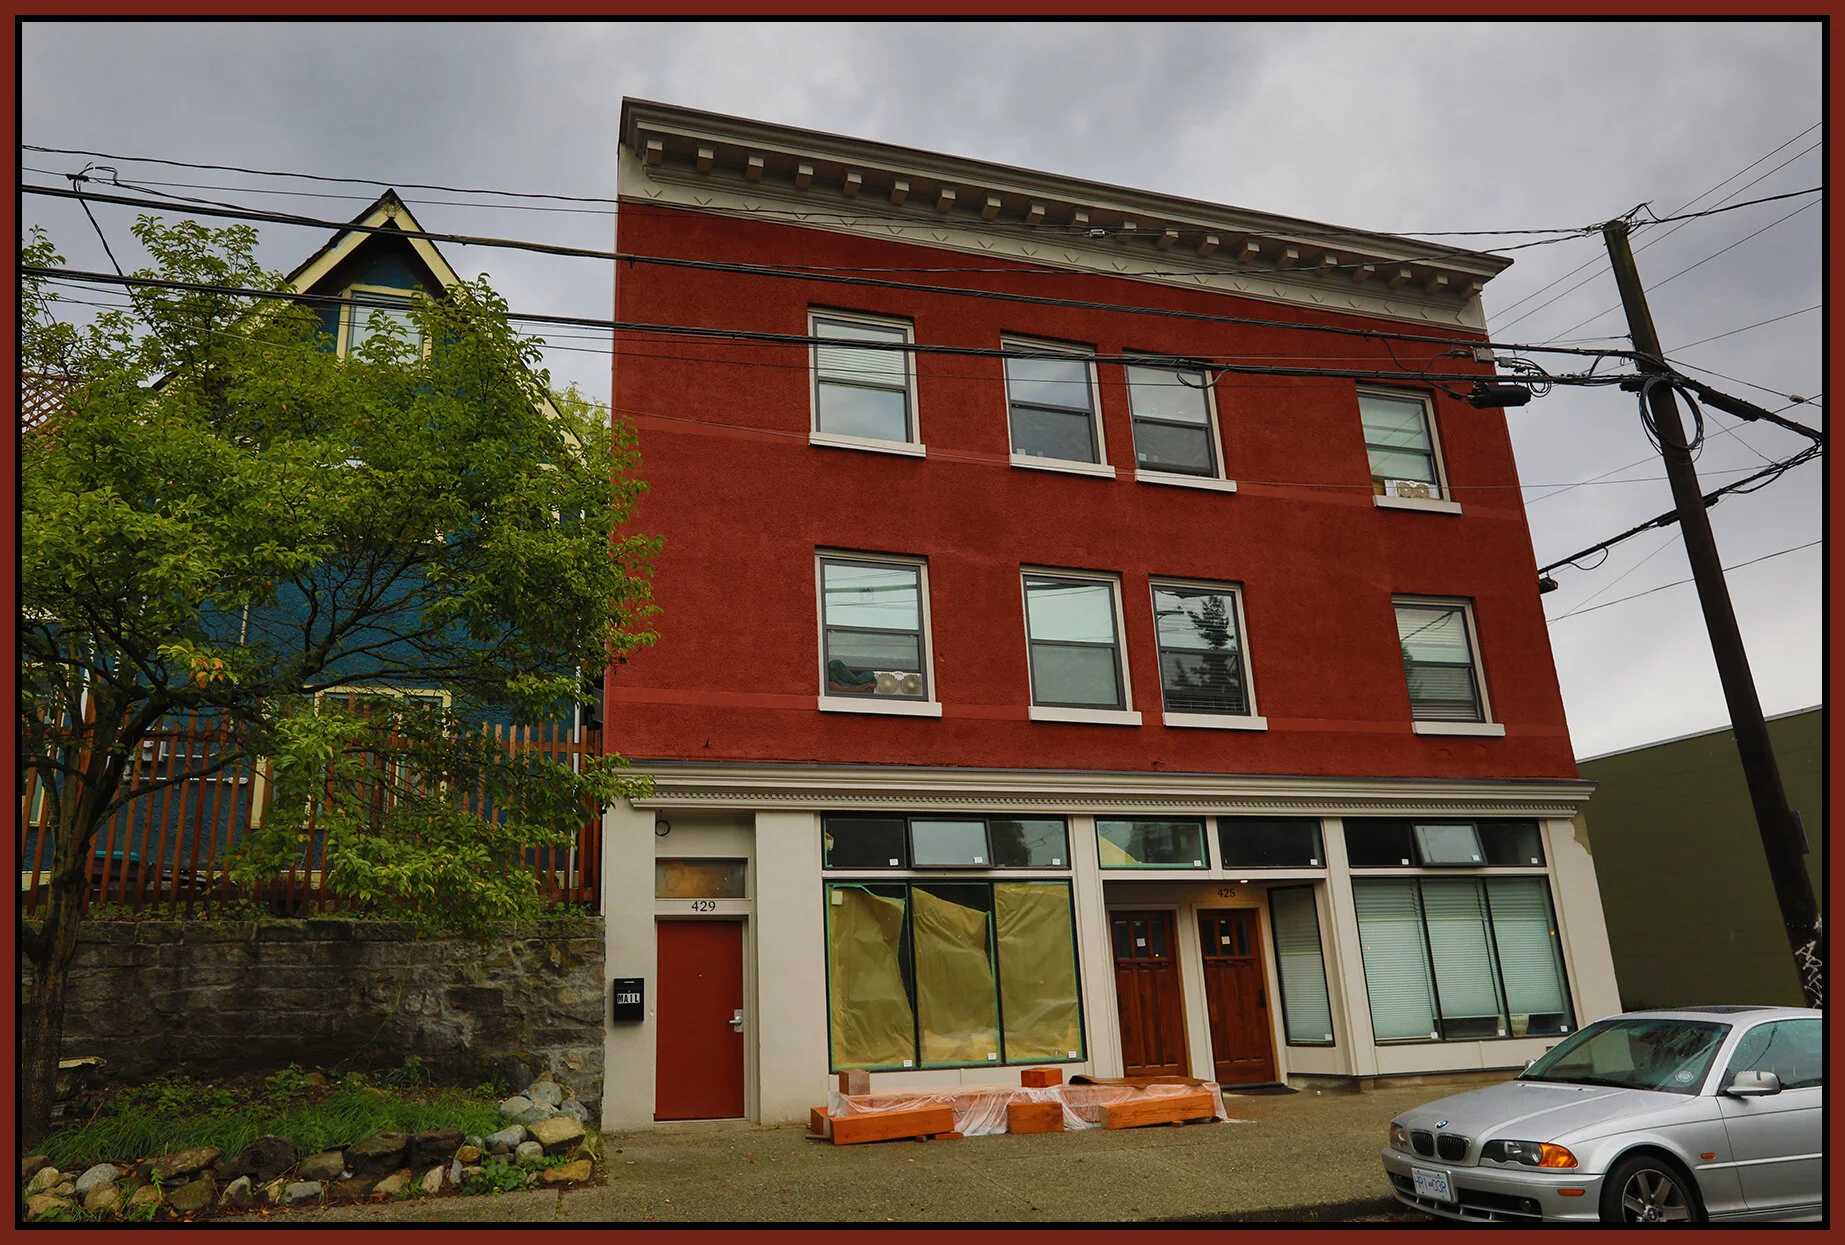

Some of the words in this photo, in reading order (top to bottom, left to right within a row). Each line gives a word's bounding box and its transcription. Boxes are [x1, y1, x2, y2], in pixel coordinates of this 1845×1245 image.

[1217, 887, 1236, 898] 425
[691, 900, 716, 912] 429
[617, 992, 641, 1004] MAIL
